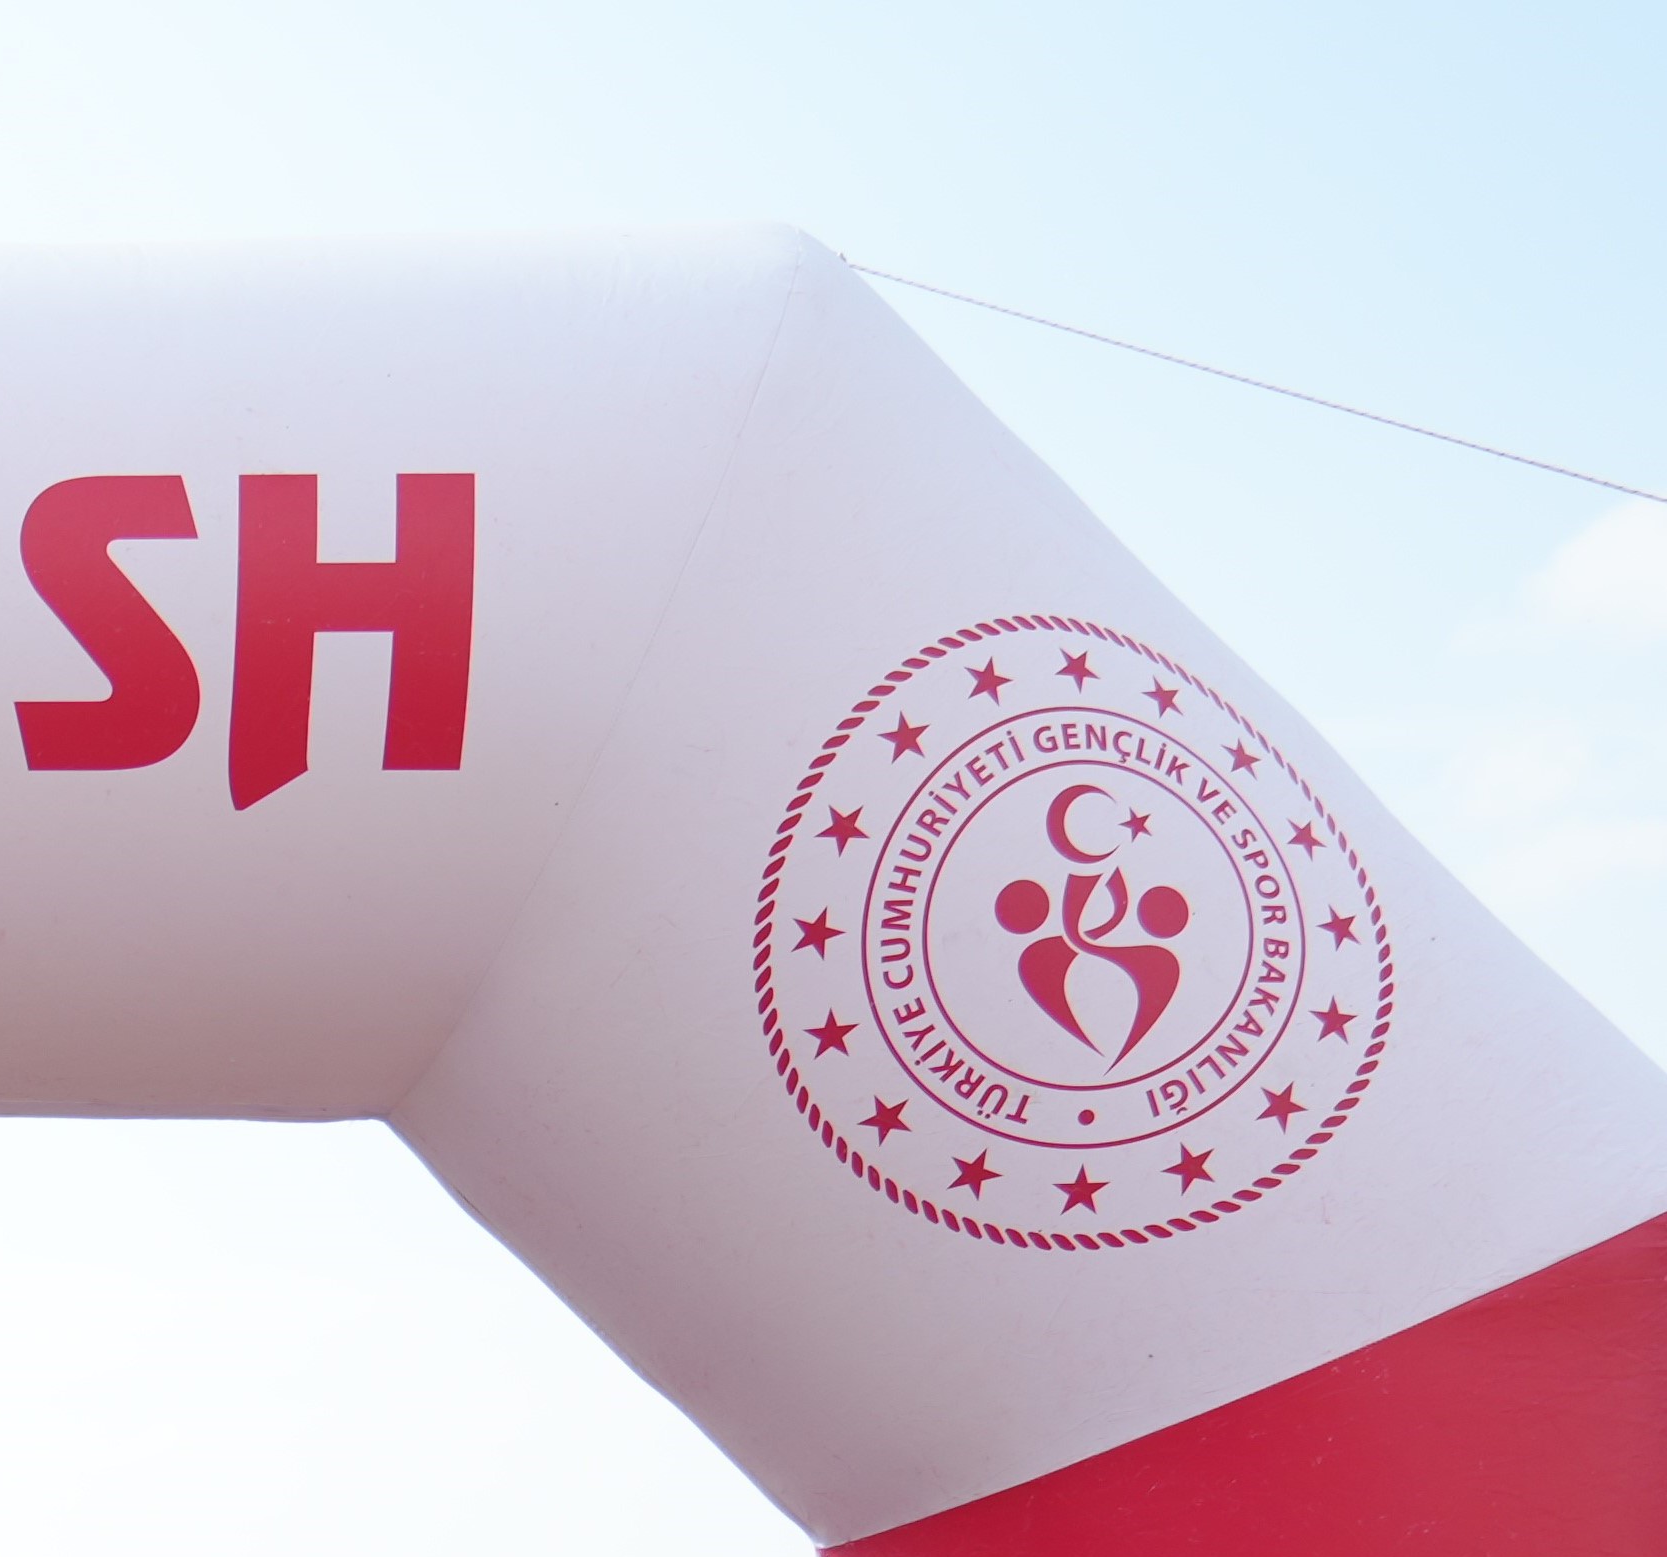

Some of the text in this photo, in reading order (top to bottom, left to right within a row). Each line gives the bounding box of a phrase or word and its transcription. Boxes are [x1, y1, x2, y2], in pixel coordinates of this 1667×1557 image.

[880, 722, 1289, 1125] TÜRKİYE CUMHURİYETİ GENÇLİK VE SPOR BAKANLIĞI
